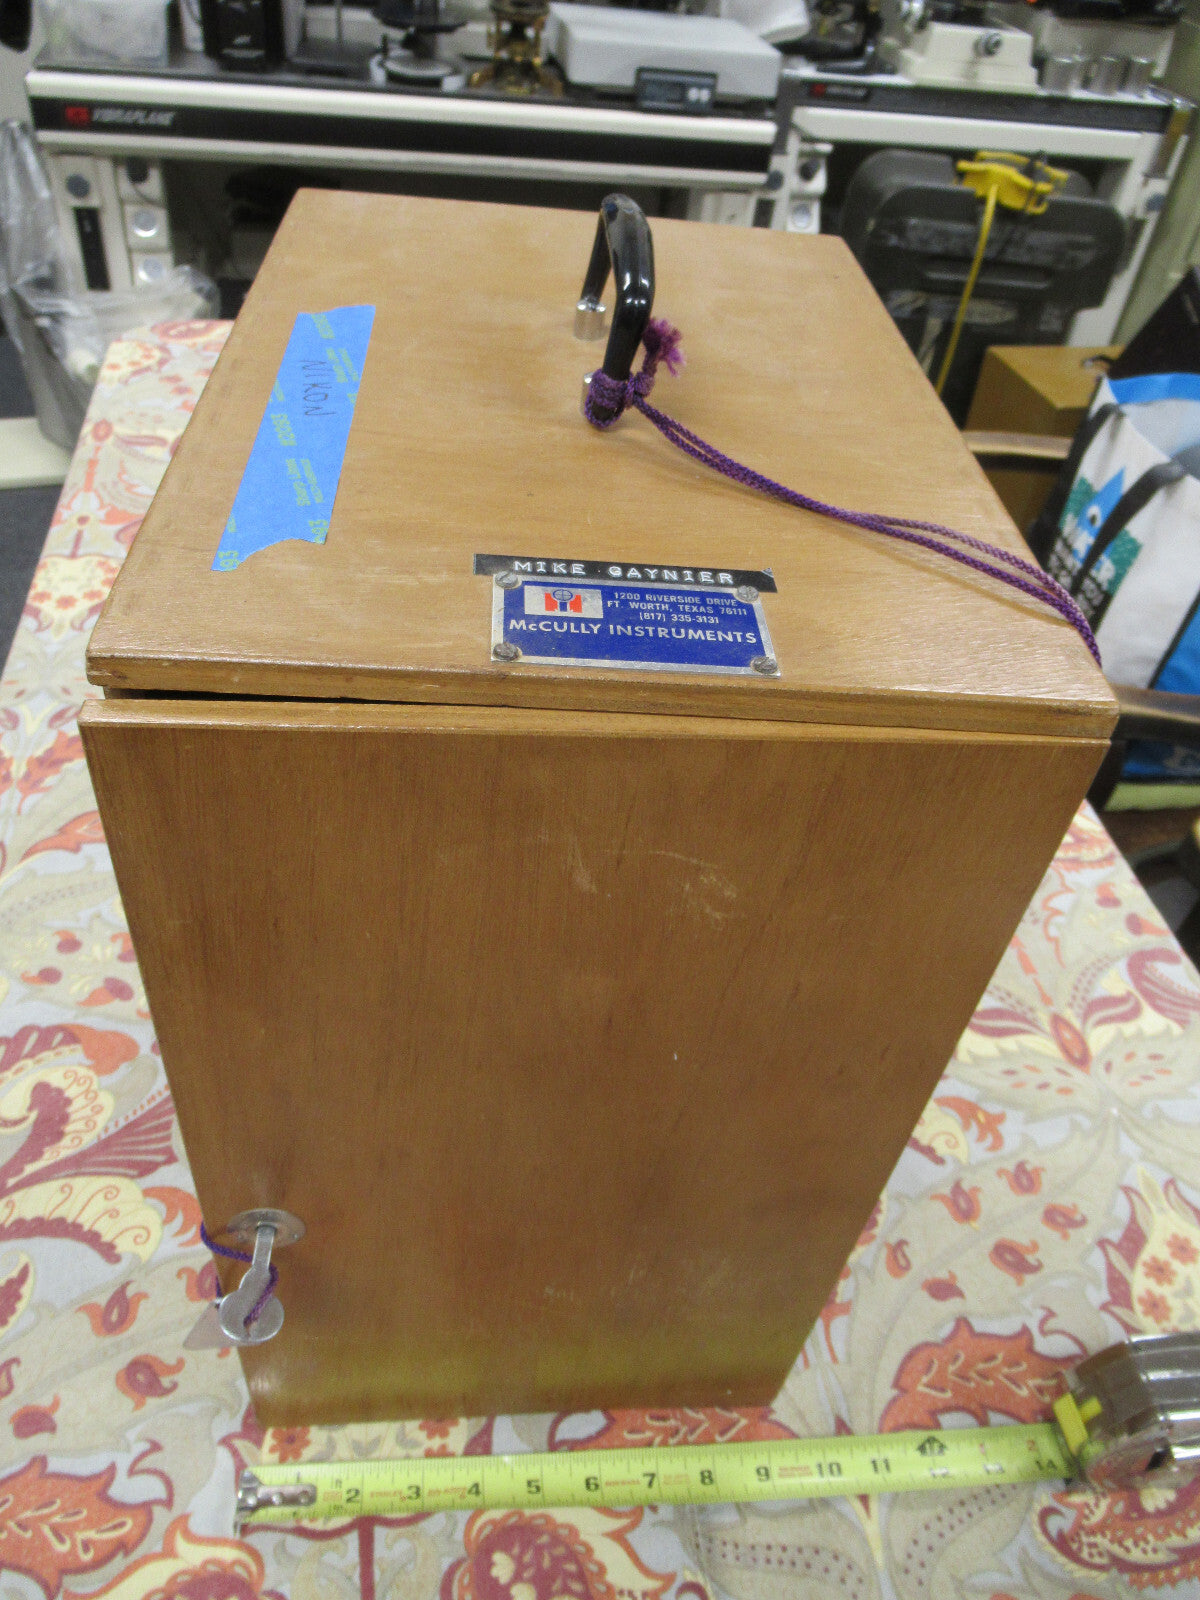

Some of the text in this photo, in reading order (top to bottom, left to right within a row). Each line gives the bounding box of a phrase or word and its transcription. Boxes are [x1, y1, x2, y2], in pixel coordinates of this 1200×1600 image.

[301, 359, 336, 417] NIKON
[513, 560, 734, 585] MIKE GAYNIER
[607, 600, 623, 609] FT.
[678, 604, 714, 614] TEXAS
[613, 591, 738, 607] 1200 RIVERSIDE DRIVE
[639, 612, 719, 624] (817) 335-3131
[509, 619, 757, 644] McCULLY INSTRUMENTS
[345, 1487, 361, 1503] 2
[406, 1485, 421, 1500] 3
[467, 1482, 481, 1497] 4
[526, 1478, 541, 1494] 5
[585, 1475, 600, 1492] 6
[642, 1472, 656, 1489] 7
[700, 1469, 714, 1485] 8
[756, 1466, 770, 1481] 9
[816, 1460, 842, 1478] 10
[871, 1456, 891, 1474] 11
